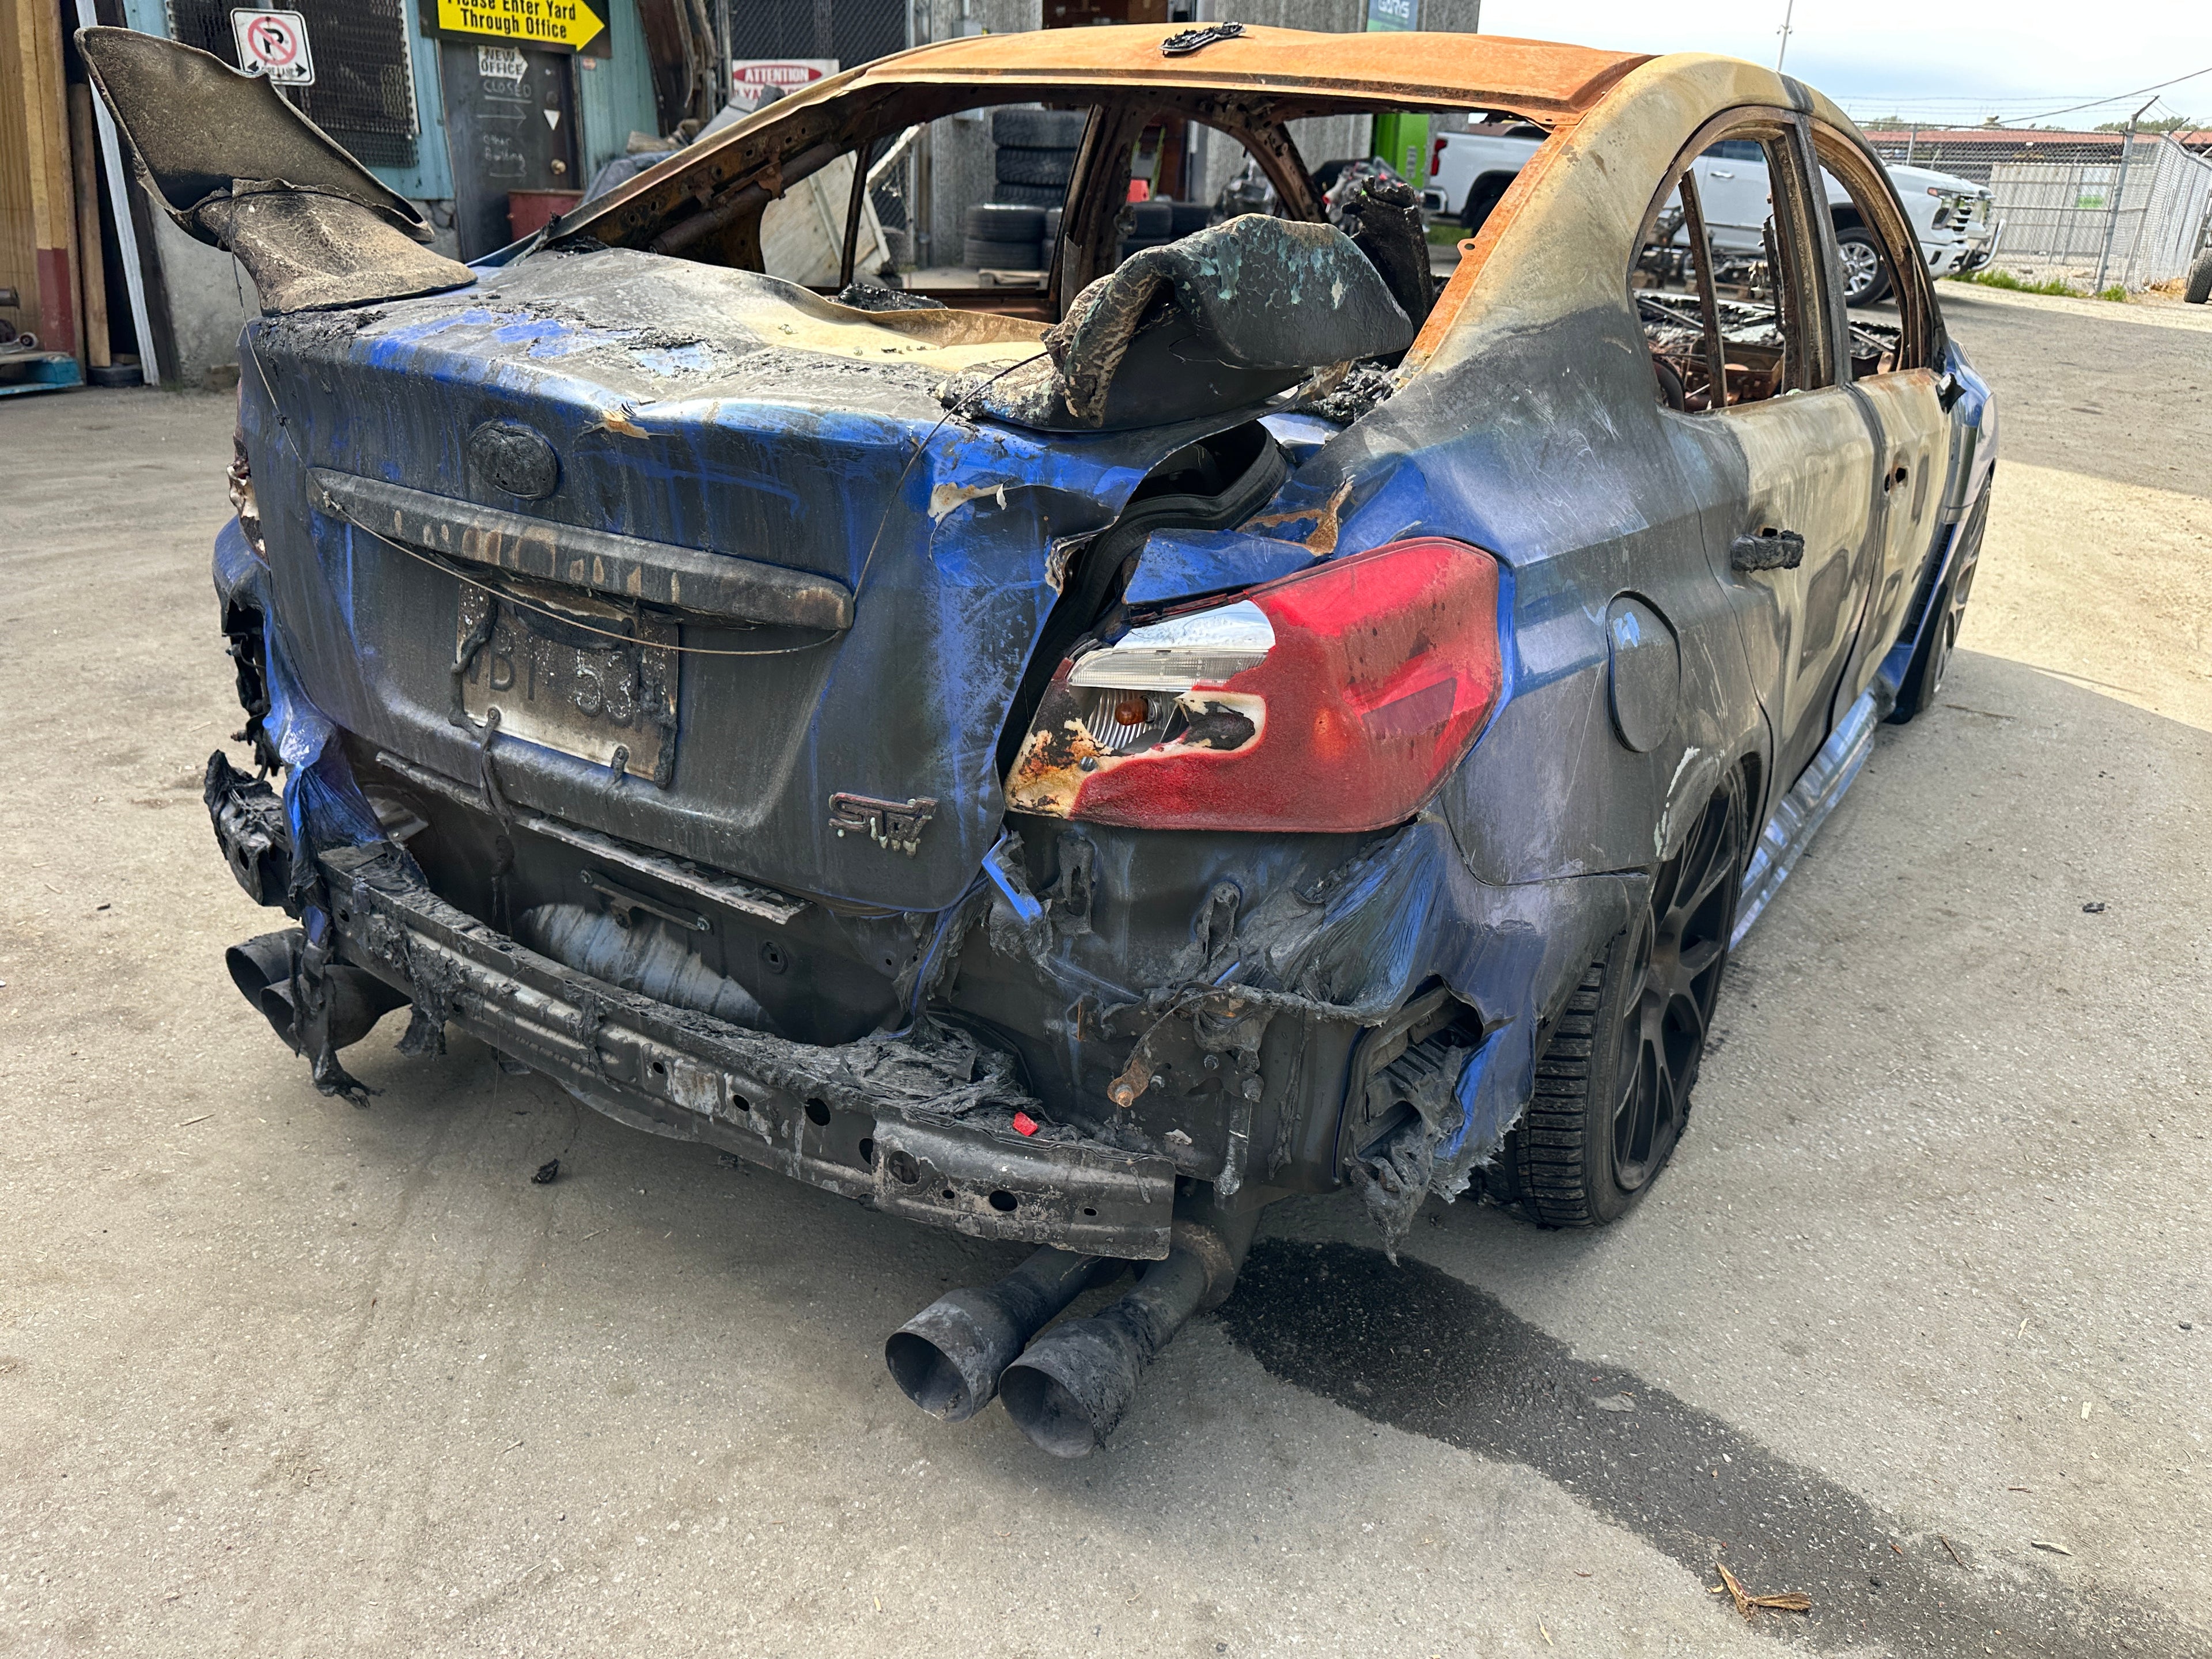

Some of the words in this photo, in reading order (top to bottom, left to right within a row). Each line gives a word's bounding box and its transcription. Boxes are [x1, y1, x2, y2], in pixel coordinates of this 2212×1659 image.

[448, 0, 495, 9] ease
[503, 0, 540, 16] Enter
[547, 0, 576, 20] Yard
[460, 8, 520, 35] Through
[525, 16, 567, 39] Office
[485, 48, 515, 62] NEW
[481, 59, 523, 75] OFFICE
[744, 67, 809, 84] ATTENTION
[484, 79, 532, 97] CLOSED
